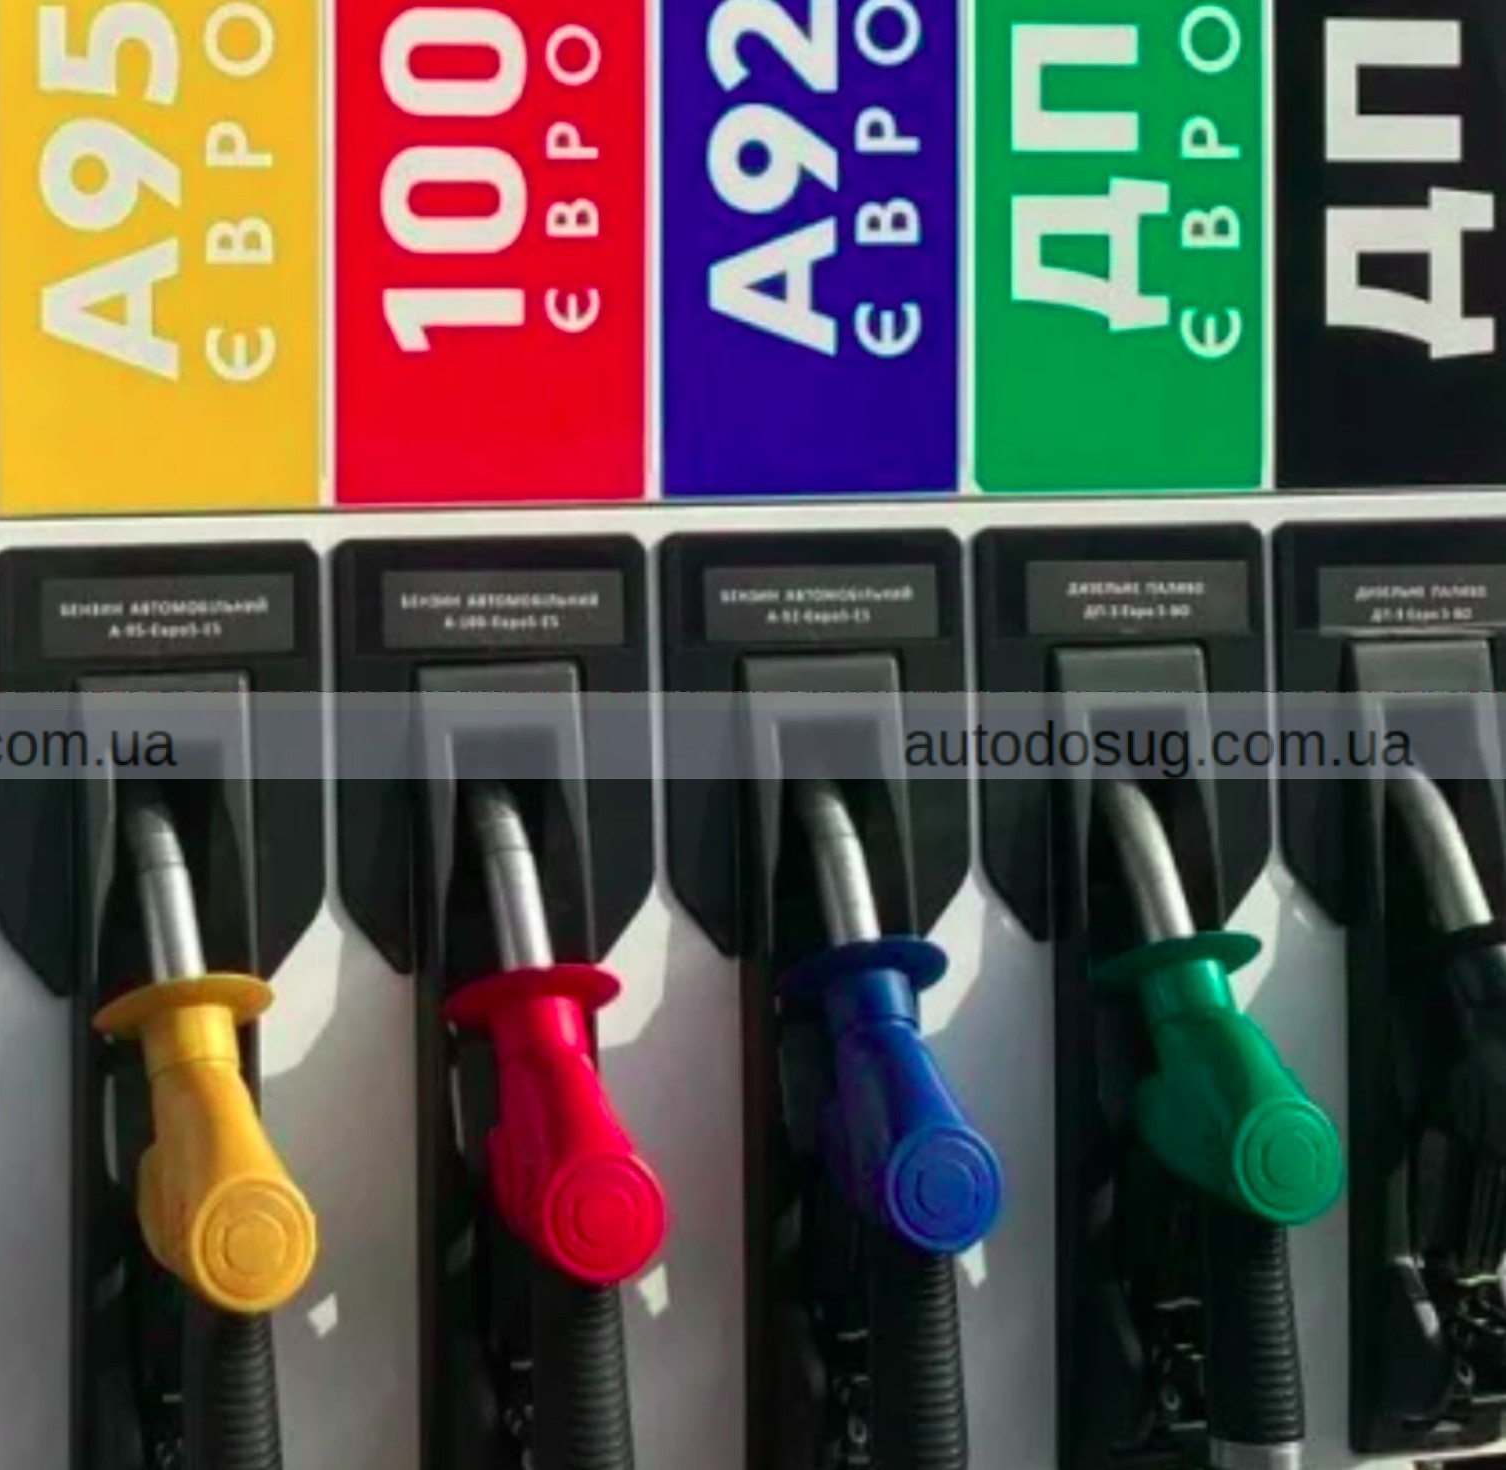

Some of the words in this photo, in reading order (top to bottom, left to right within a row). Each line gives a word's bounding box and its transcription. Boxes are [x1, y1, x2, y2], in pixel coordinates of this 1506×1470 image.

[38, 2, 182, 381] А95
[204, 2, 277, 382] ЄВРО
[380, 7, 528, 352] 100
[545, 24, 601, 333] ЄВРО
[853, 0, 922, 357] ЄВРО
[1010, 24, 1170, 332] ДП
[1179, 5, 1242, 358] ЄВРО
[1325, 18, 1495, 359] ДП
